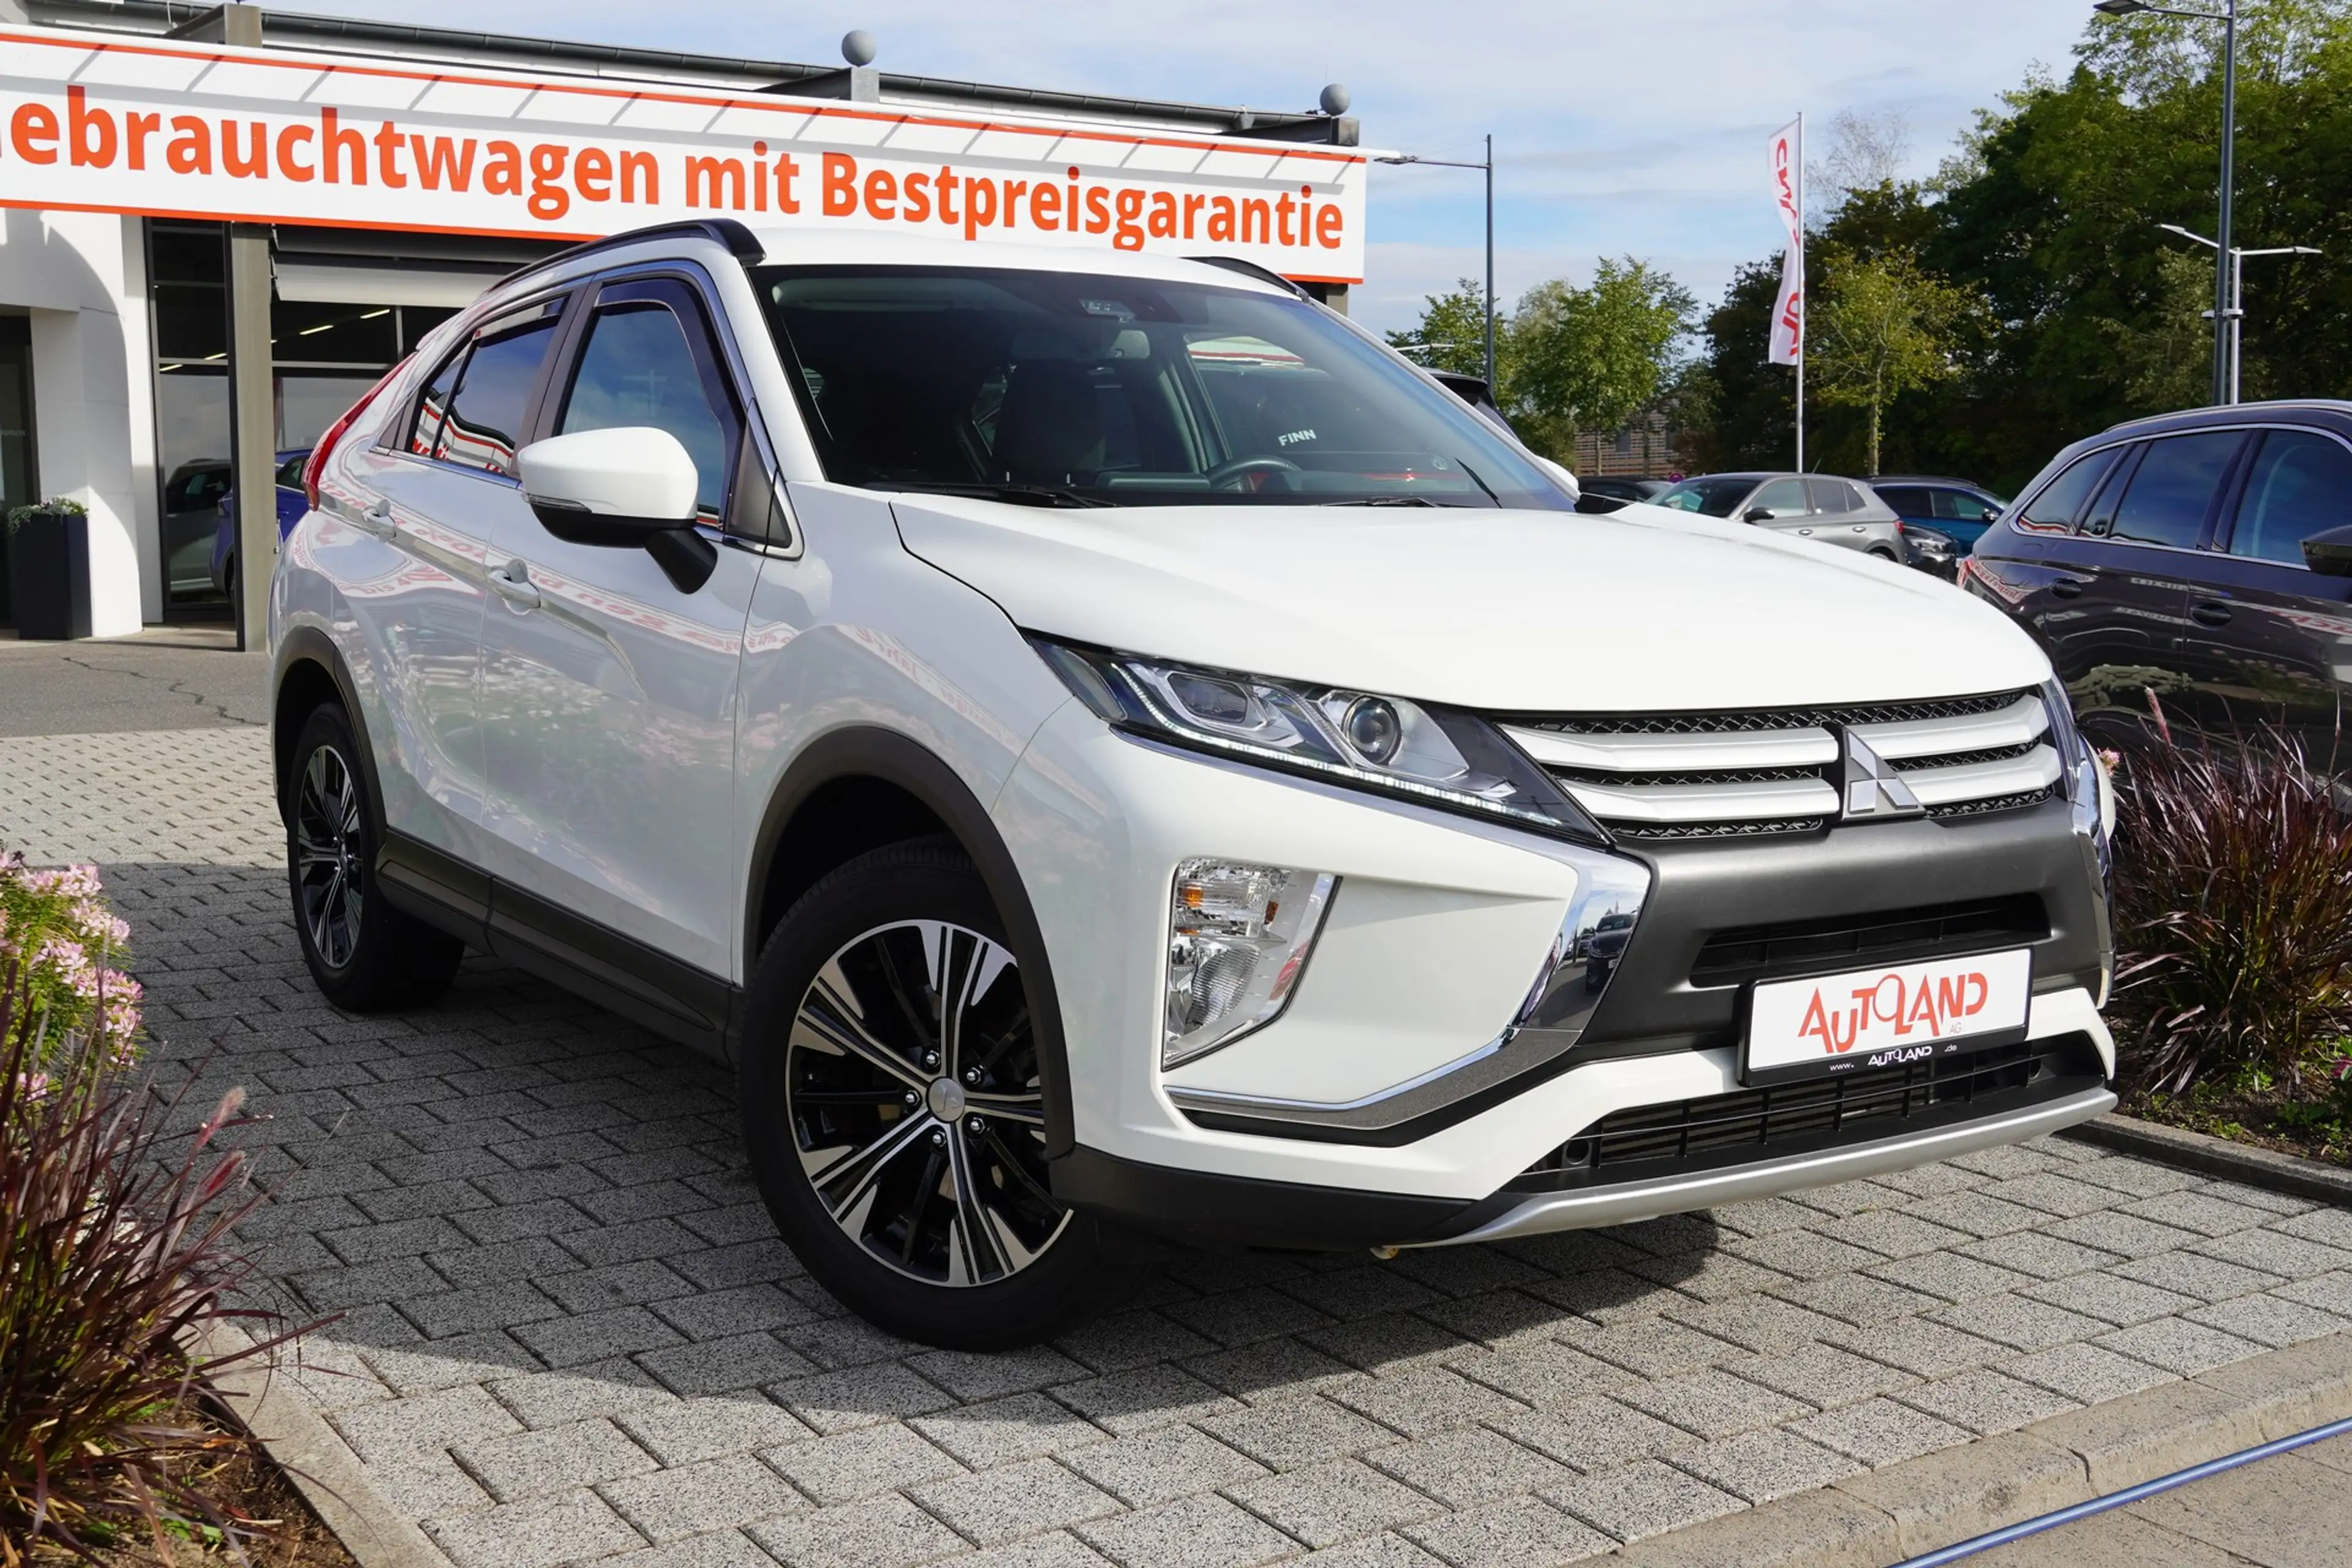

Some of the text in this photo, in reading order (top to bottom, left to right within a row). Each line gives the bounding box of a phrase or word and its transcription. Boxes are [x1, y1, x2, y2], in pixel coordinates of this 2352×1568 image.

[0, 85, 1344, 254] ebrauchtwagen mit Bestpreisgarantie
[1278, 429, 1316, 447] FINN
[1798, 972, 1988, 1054] AUTOLAND
[1950, 1022, 1962, 1035] AG
